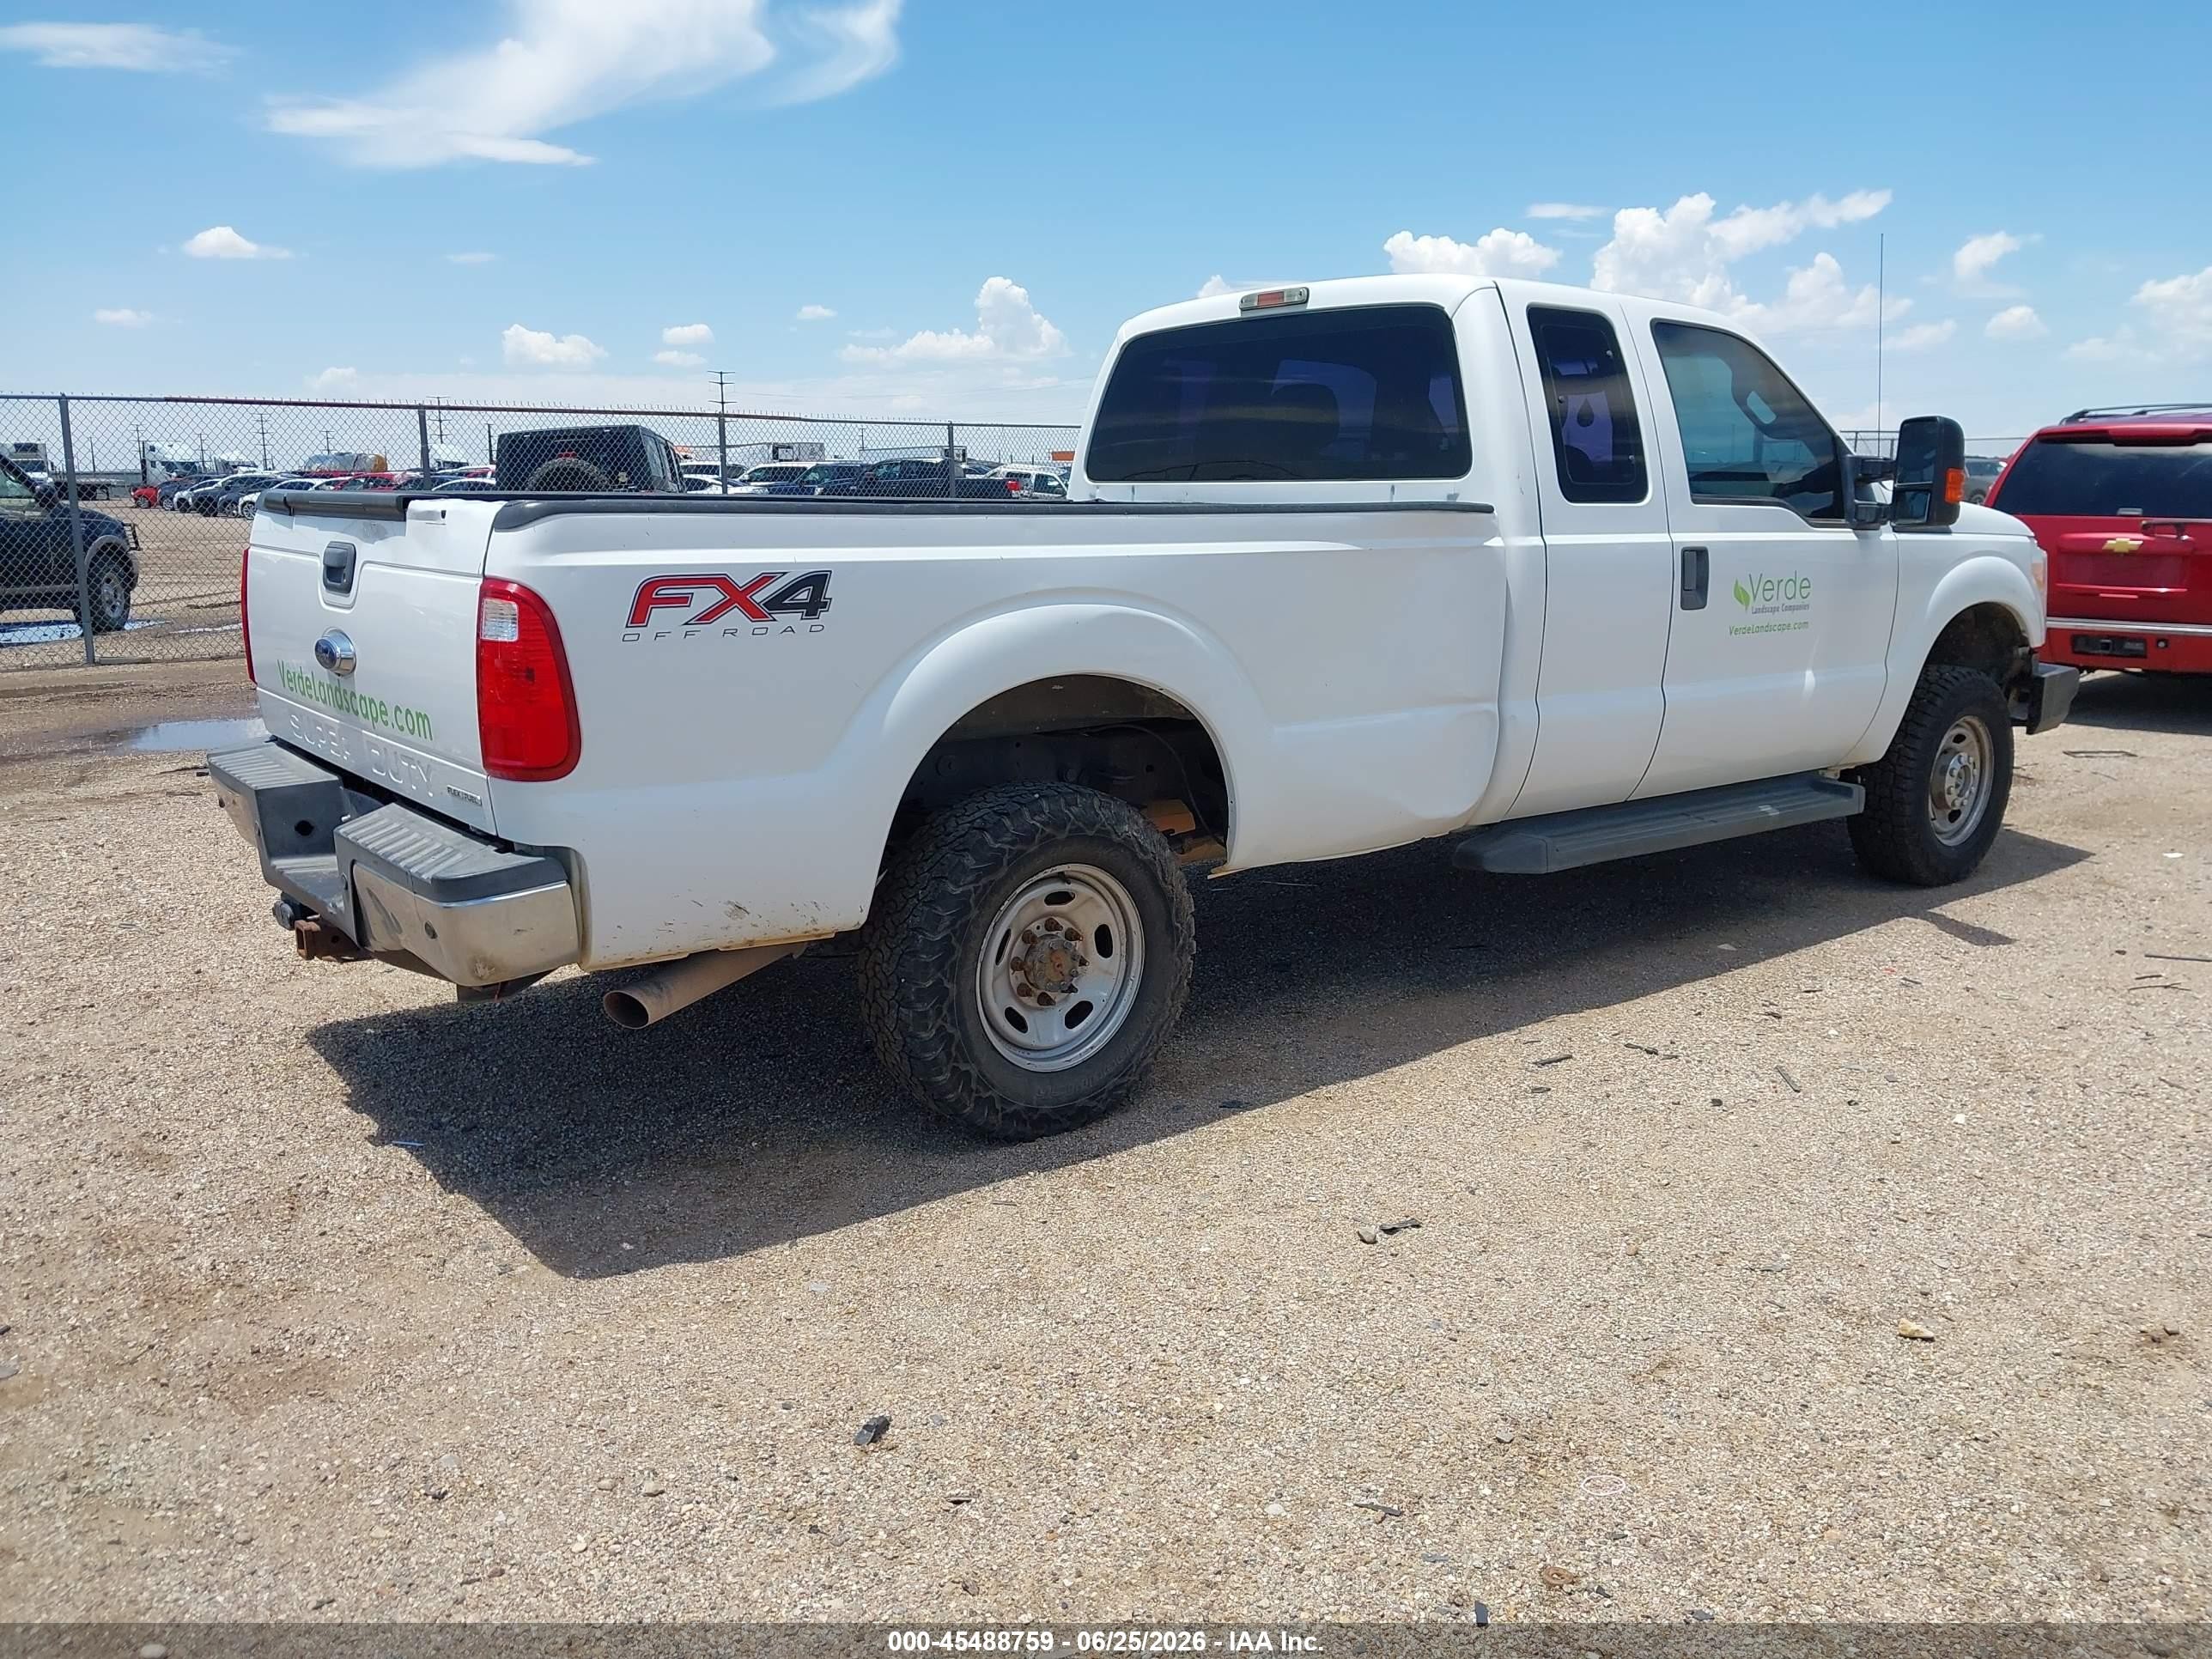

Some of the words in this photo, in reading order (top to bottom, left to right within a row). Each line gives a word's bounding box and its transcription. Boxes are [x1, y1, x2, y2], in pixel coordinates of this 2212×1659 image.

[625, 569, 833, 628] FX4
[1748, 570, 1811, 603] Verde
[1751, 605, 1780, 615] Landscape
[1781, 603, 1810, 613] Companies
[621, 629, 702, 642] OFF
[722, 623, 825, 638] ROAD
[289, 714, 353, 762] SUPER
[367, 740, 434, 798] DUTY
